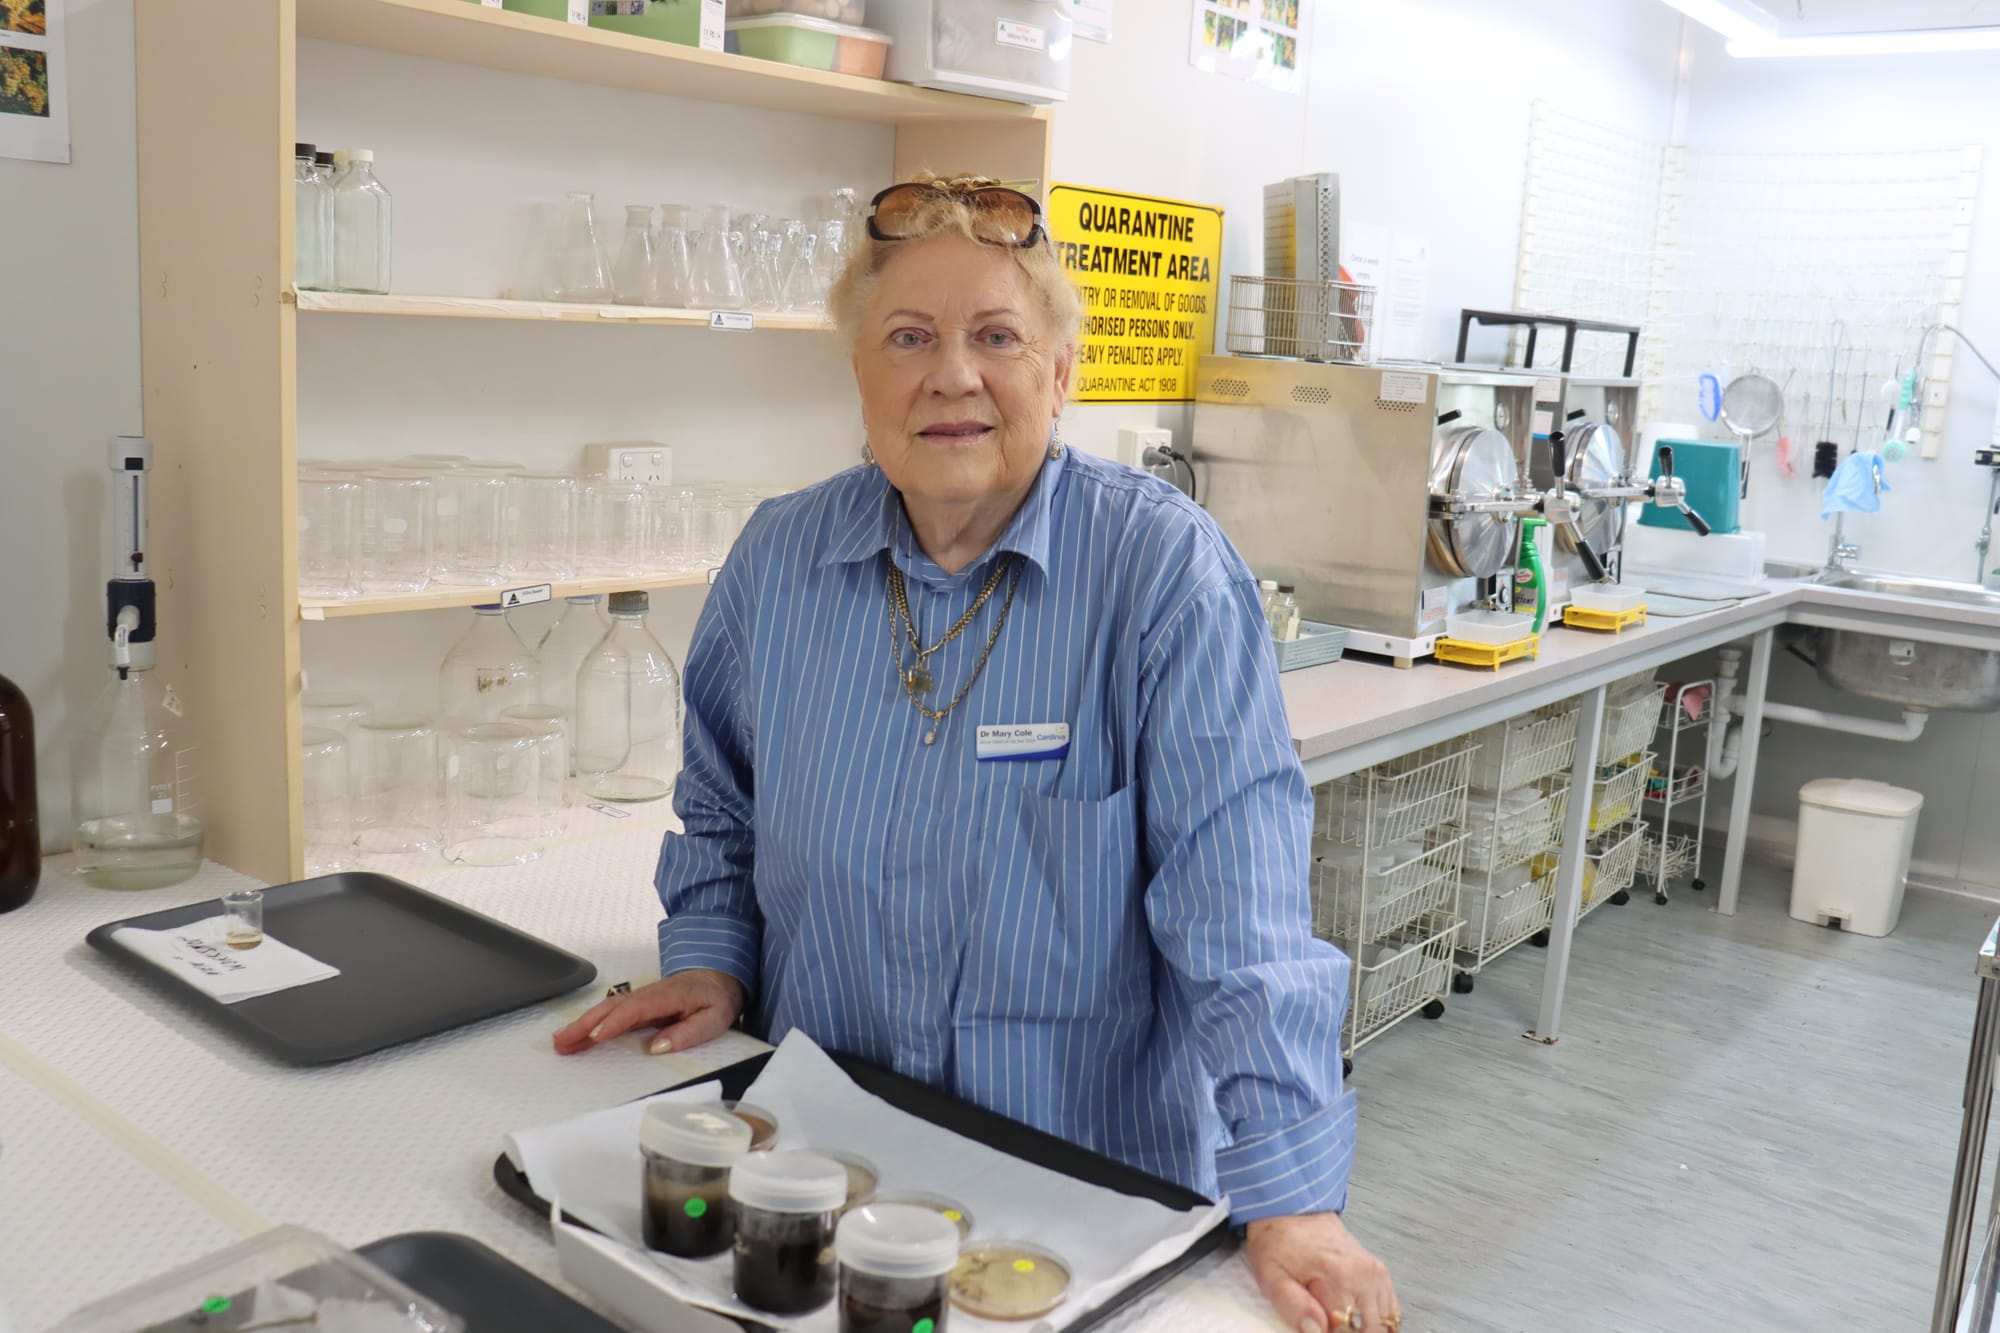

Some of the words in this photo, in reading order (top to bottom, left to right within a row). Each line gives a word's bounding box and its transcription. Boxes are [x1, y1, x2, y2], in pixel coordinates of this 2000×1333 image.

[1079, 202, 1195, 243] QUARANTINE
[1055, 240, 1162, 278] TREATMENT
[1167, 253, 1210, 283] AREA
[1103, 288, 1117, 307] OR
[1120, 289, 1161, 311] REMOVAL
[1164, 292, 1175, 312] OF
[1178, 293, 1208, 314] GOODS.
[1129, 318, 1169, 338] PERSONS
[1173, 320, 1195, 340] ONLY.
[1107, 345, 1153, 366] PENALTIES
[1156, 347, 1184, 366] APPLY.
[1078, 377, 1135, 392] QUARANTINE
[1139, 377, 1156, 392] ACT
[1159, 378, 1177, 392] 1908
[992, 730, 1012, 738] Mary
[1014, 729, 1032, 737] Cole
